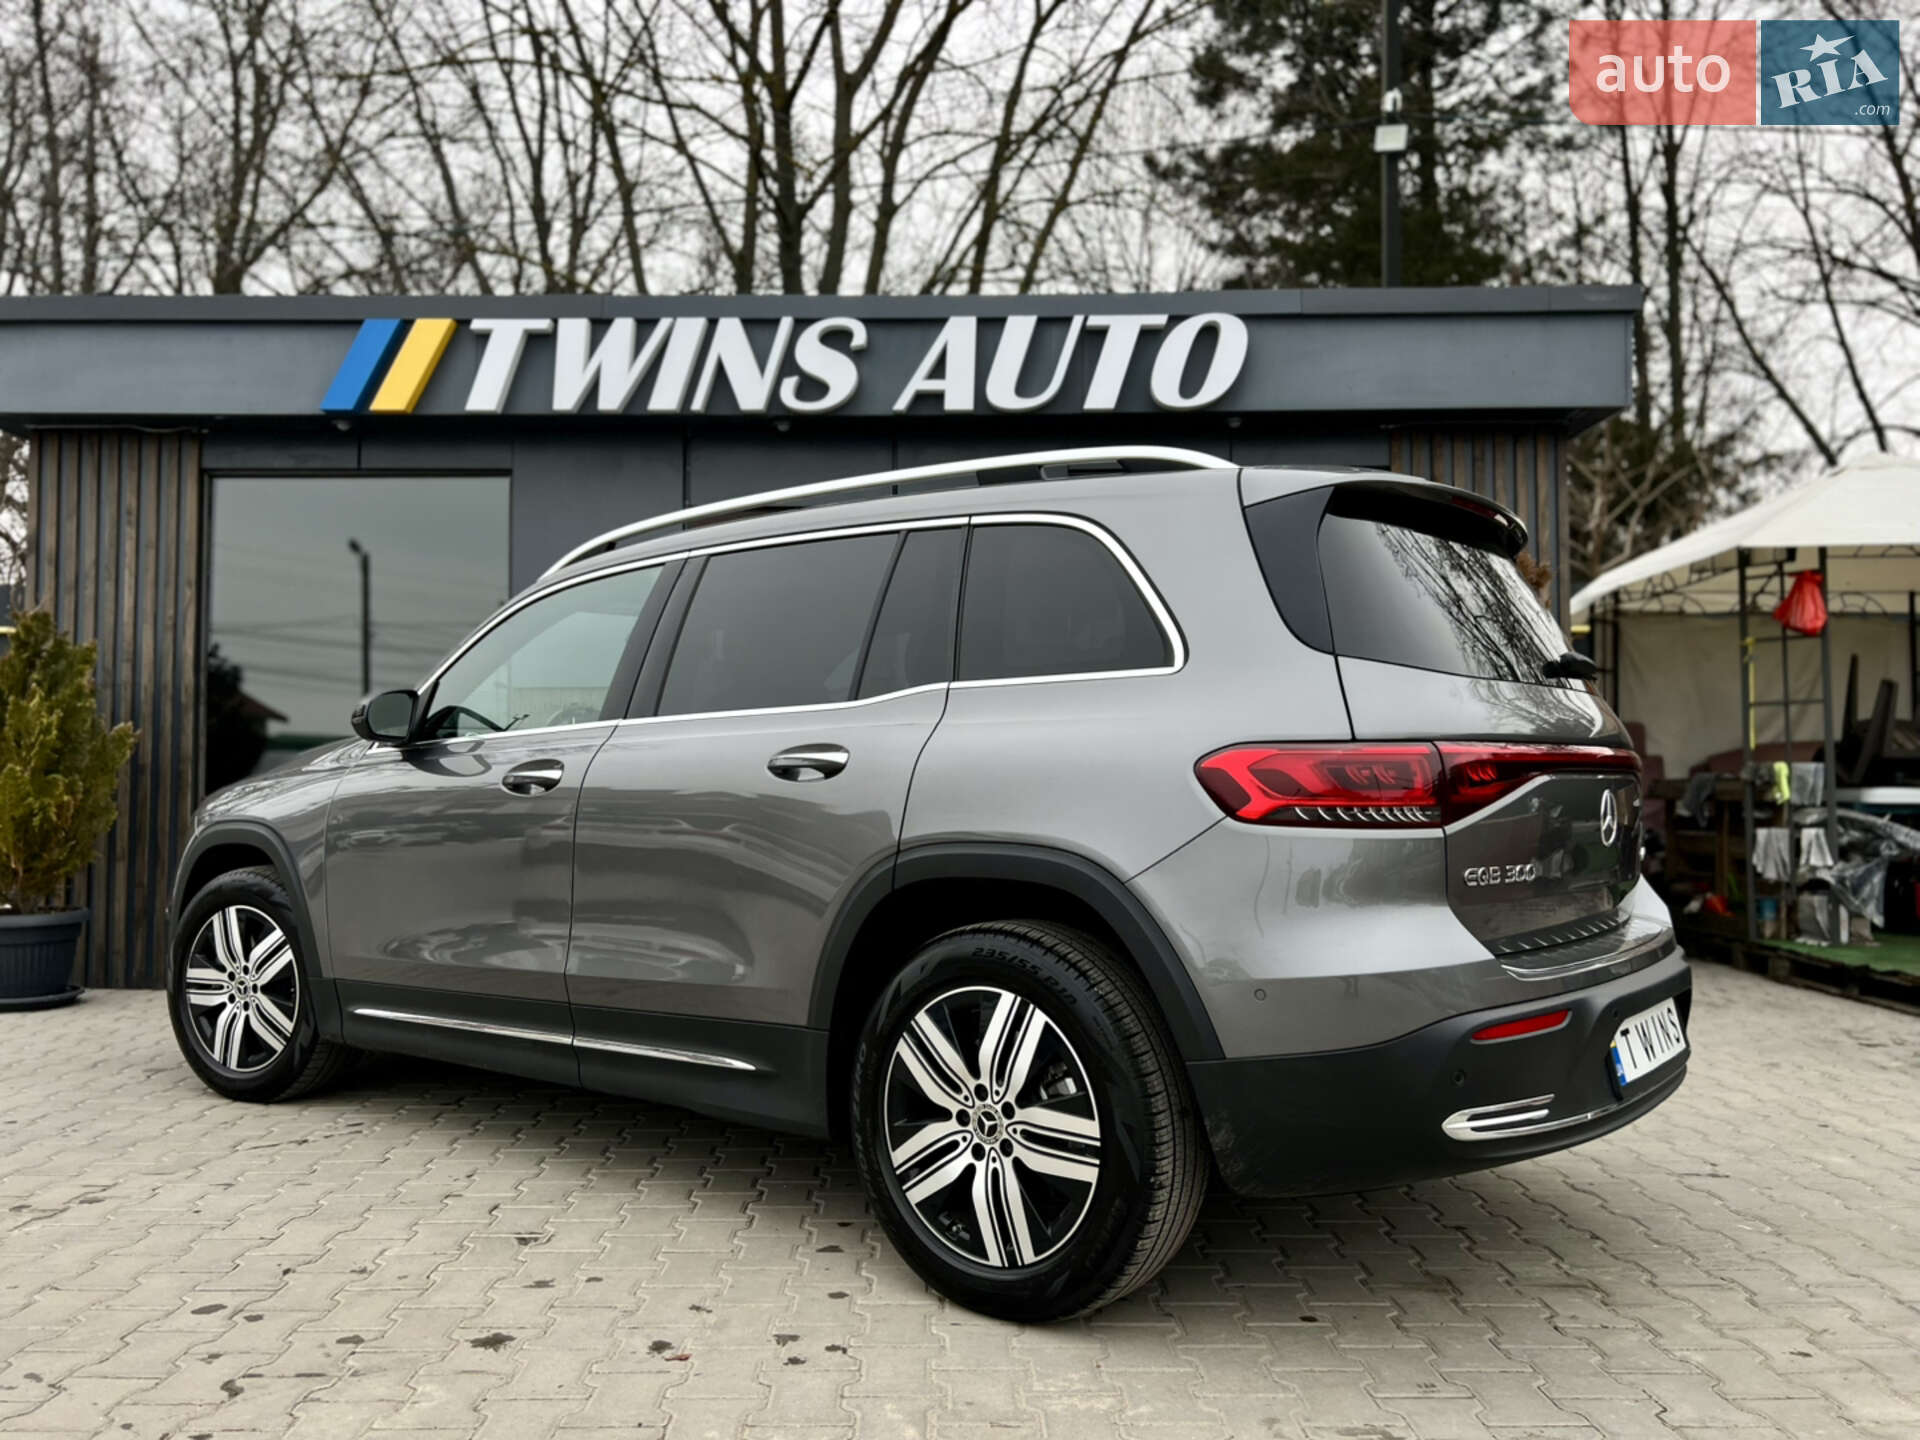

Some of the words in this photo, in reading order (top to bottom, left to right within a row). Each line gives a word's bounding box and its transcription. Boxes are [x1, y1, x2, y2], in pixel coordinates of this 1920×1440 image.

[465, 315, 868, 413] TWINS
[892, 312, 1249, 412] AUTO
[1464, 866, 1501, 886] EQB
[1505, 864, 1536, 883] 300
[1620, 1007, 1681, 1069] TWINS
